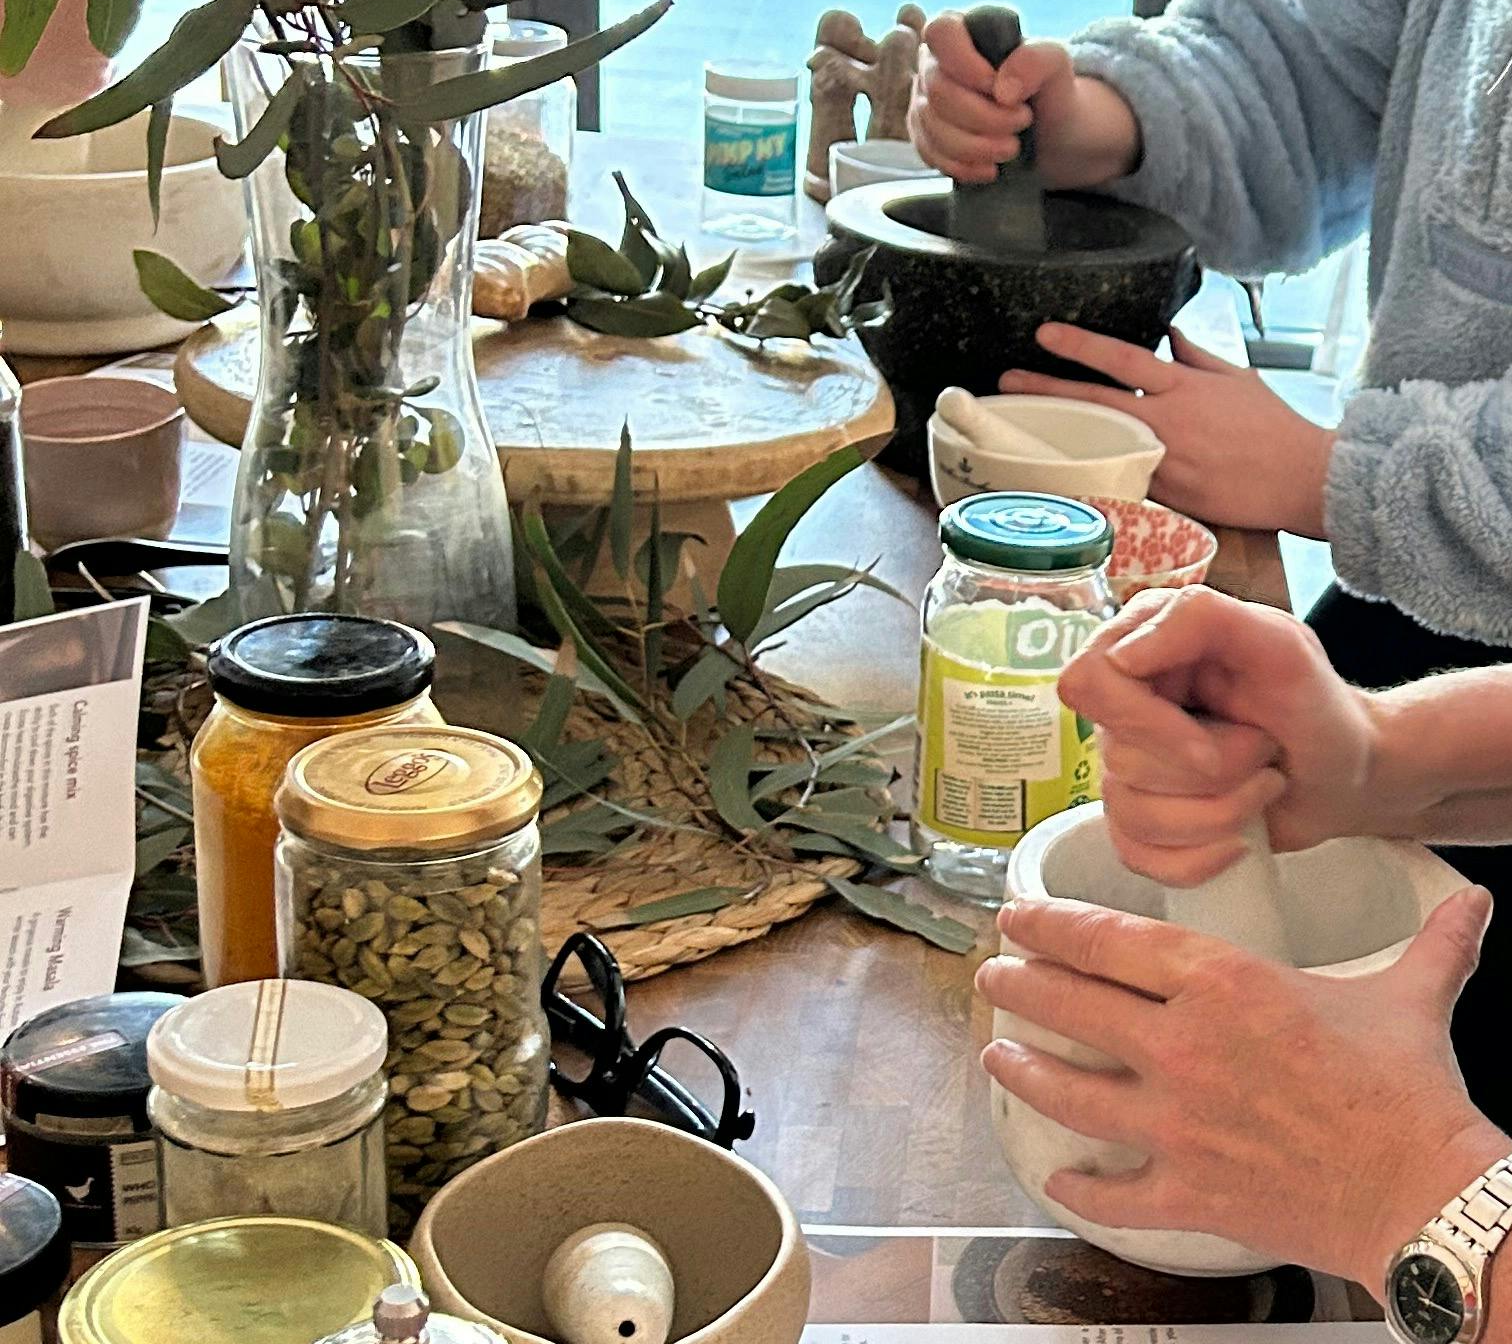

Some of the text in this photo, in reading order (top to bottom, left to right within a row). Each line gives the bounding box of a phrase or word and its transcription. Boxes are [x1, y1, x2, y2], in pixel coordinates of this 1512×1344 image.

[64, 700, 87, 800] Calming spice mix
